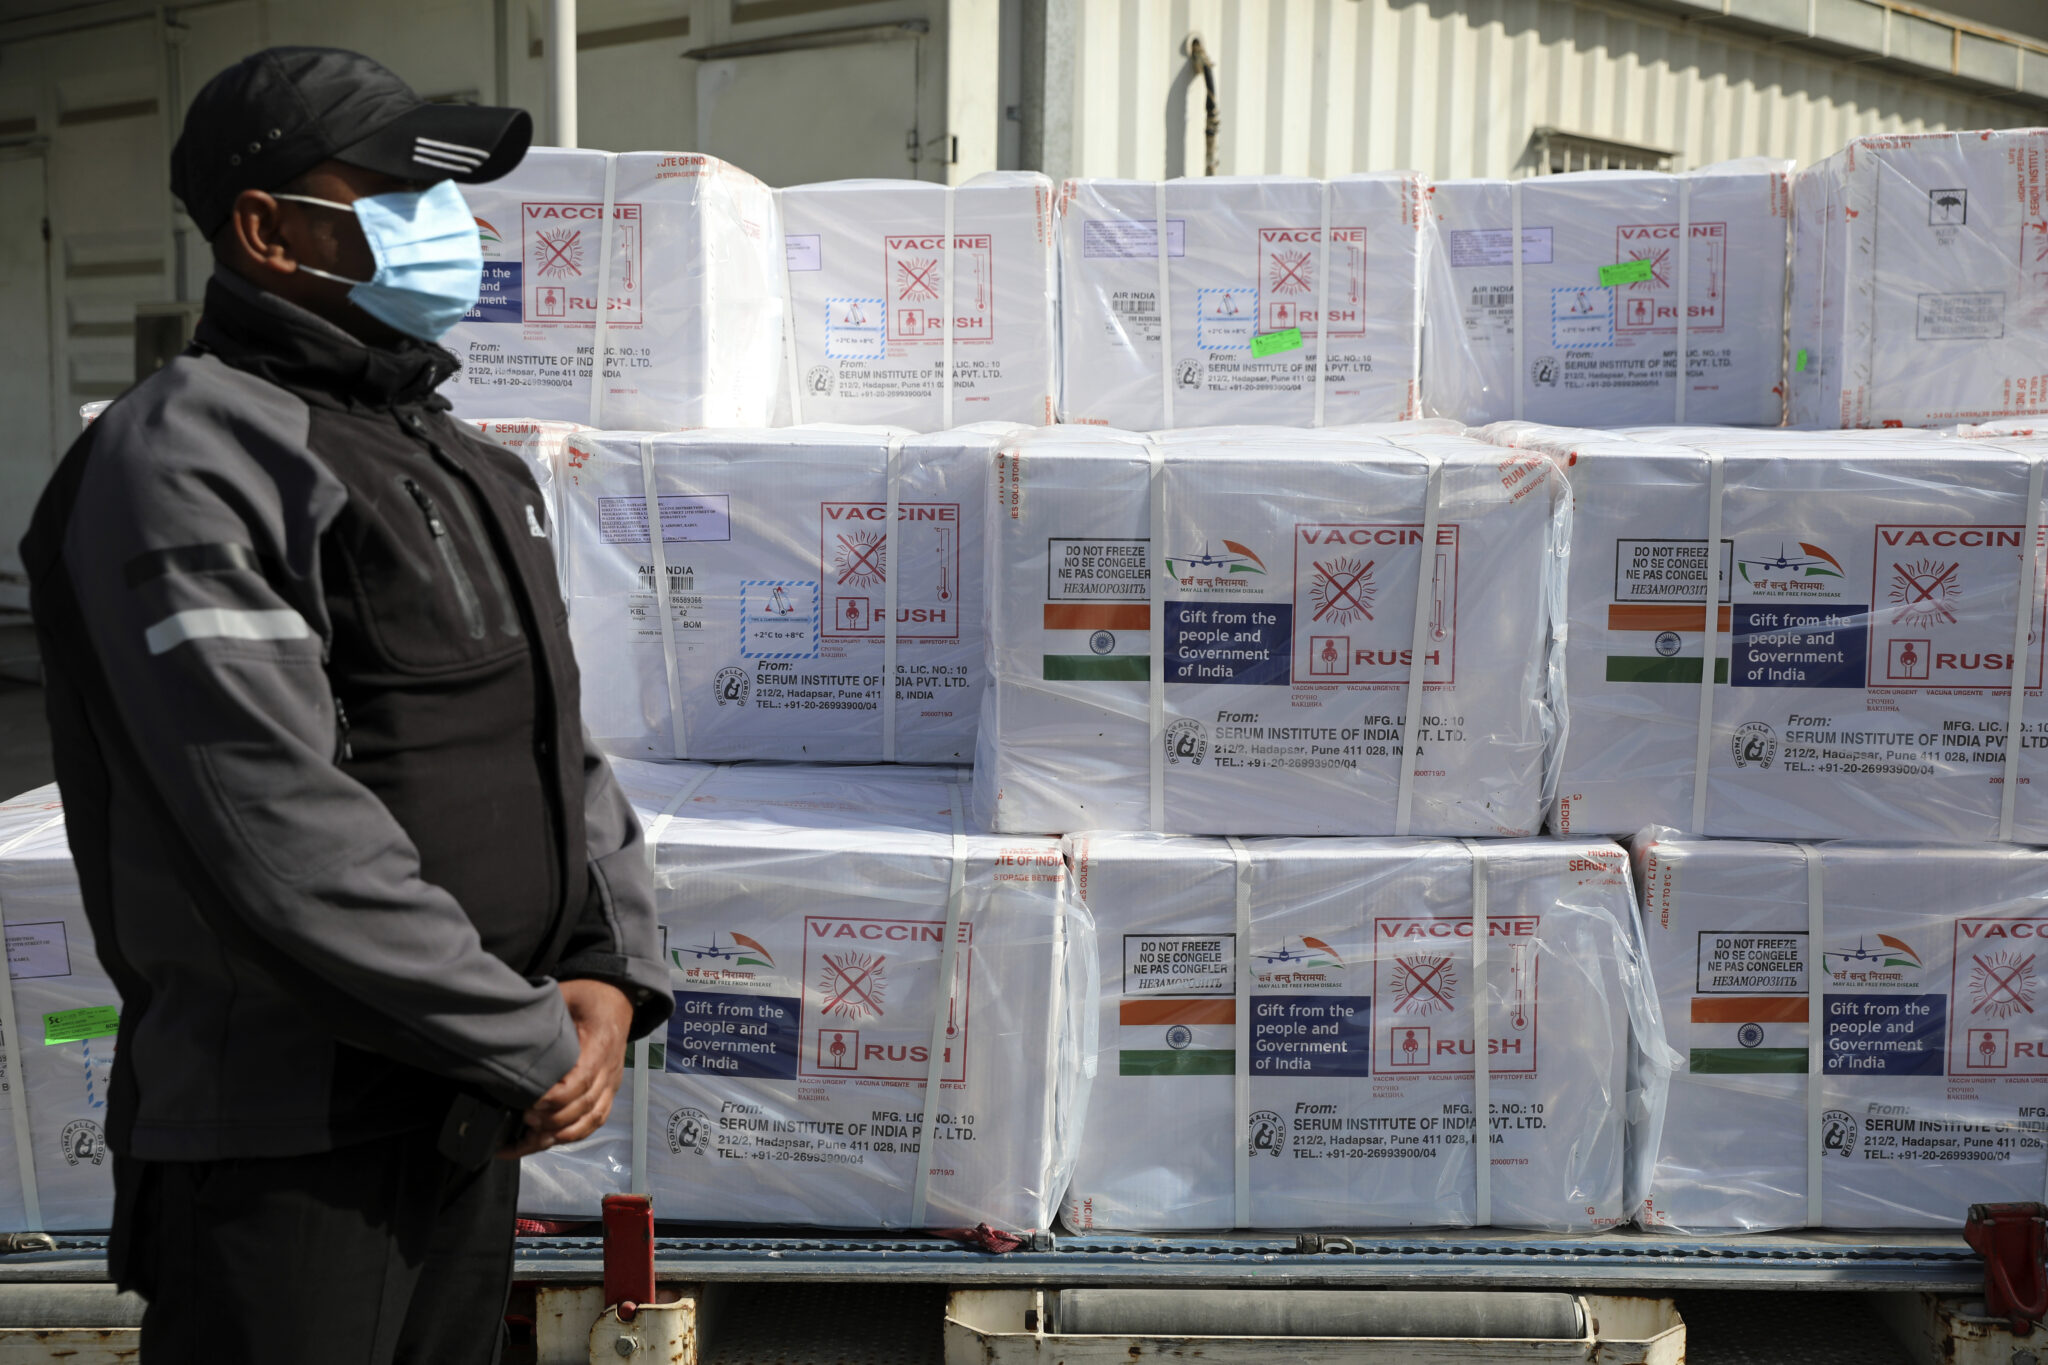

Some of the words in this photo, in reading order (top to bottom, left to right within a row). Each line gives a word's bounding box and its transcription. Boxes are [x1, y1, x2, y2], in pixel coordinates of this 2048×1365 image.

[1263, 231, 1364, 243] VACCNE
[493, 268, 510, 278] the
[470, 341, 500, 352] From:
[469, 354, 504, 364] SERUM
[507, 355, 557, 365] INSTITUTE
[560, 357, 573, 365] OF
[1209, 352, 1237, 362] From:
[840, 360, 867, 369] From:
[1208, 364, 1240, 372] SERUM
[1243, 364, 1288, 372] INSTITUTE
[1290, 364, 1302, 372] OF
[1565, 360, 1597, 370] SERUM
[1599, 360, 1645, 369] INSTITUTE
[1648, 360, 1661, 368] OF
[839, 371, 870, 379] SERUM
[873, 371, 918, 379] INSTITUTE
[921, 371, 932, 379] OF
[496, 424, 528, 434] SERUM
[1301, 530, 1454, 545] VACCINE
[1066, 546, 1080, 556] DO
[1083, 546, 1104, 556] NOT
[1106, 546, 1145, 556] FREEZE
[1635, 547, 1649, 557] DO
[1652, 547, 1673, 557] NOT
[1065, 558, 1079, 567] NO
[1082, 558, 1095, 567] SE
[1097, 558, 1146, 567] CONGELE
[1058, 568, 1072, 578] NE
[1075, 569, 1094, 578] PAS
[1180, 610, 1207, 623] Gift
[1212, 612, 1246, 624] from
[1252, 612, 1276, 624] the
[1750, 614, 1778, 626] Gift
[1784, 615, 1820, 627] from
[1179, 630, 1228, 644] people
[1234, 630, 1261, 642] and
[1749, 634, 1800, 648] people
[1807, 633, 1834, 645] and
[1179, 647, 1269, 660] Government
[1749, 651, 1844, 664] Government
[758, 661, 793, 671] From:
[910, 666, 929, 674] LIC.
[932, 666, 954, 674] NO.:
[956, 666, 967, 674] 10
[1178, 664, 1194, 677] of
[1198, 665, 1233, 677] India
[1748, 668, 1764, 680] of
[1769, 668, 1805, 681] India
[756, 675, 797, 686] SERUM
[801, 676, 859, 686] INSTITUTE
[916, 677, 941, 687] PVT.
[945, 678, 969, 688] LTD.
[838, 690, 862, 698] Pune
[865, 691, 881, 699] 411
[907, 691, 933, 700] INDIA
[756, 700, 781, 709] TEL.:
[1217, 711, 1259, 723] From:
[1788, 715, 1832, 727] From:
[1943, 721, 1975, 732] MFG.
[1215, 728, 1264, 740] SERUM
[1268, 728, 1337, 741] INSTITUTE
[1364, 729, 1399, 741] INDIA
[1841, 732, 1914, 746] INSTITUTE
[1942, 734, 1980, 747] INDIA
[1312, 745, 1340, 755] Pune
[1785, 761, 1815, 773] TEL.:
[1381, 921, 1534, 937] VACCNE
[1141, 942, 1156, 951] DO
[1158, 942, 1179, 951] NOT
[1181, 941, 1221, 952] FREEZE
[1716, 939, 1731, 949] DO
[1734, 939, 1754, 949] NOT
[1173, 953, 1221, 963] CONGELE
[1714, 951, 1729, 960] NO
[1732, 951, 1745, 960] SE
[1748, 951, 1797, 960] CONGELE
[1150, 964, 1169, 974] PAS
[684, 1001, 713, 1015] Gift
[718, 1002, 754, 1017] from
[758, 1004, 784, 1018] the
[1257, 1004, 1285, 1017] Gift
[1289, 1005, 1325, 1017] from
[1330, 1005, 1355, 1017] the
[1831, 1002, 1859, 1015] Gift
[1864, 1004, 1899, 1015] from
[1905, 1003, 1930, 1015] the
[684, 1020, 735, 1037] people
[740, 1022, 768, 1036] and
[1257, 1023, 1307, 1036] people
[1312, 1022, 1339, 1035] and
[1830, 1021, 1881, 1035] people
[1886, 1021, 1914, 1033] and
[683, 1037, 776, 1055] Government
[1256, 1040, 1347, 1052] Government
[1829, 1038, 1923, 1051] Government
[682, 1055, 698, 1069] of
[702, 1057, 739, 1071] India
[1255, 1057, 1271, 1069] of
[1276, 1057, 1311, 1070] India
[1829, 1055, 1844, 1068] of
[1849, 1056, 1886, 1069] India
[1295, 1103, 1337, 1115] From:
[719, 1117, 766, 1131] SERUM
[773, 1119, 844, 1135] INSTITUTE
[871, 1125, 908, 1139] INDIA
[947, 1128, 976, 1141] LTD.
[1293, 1118, 1341, 1131] SERUM
[1346, 1118, 1416, 1131] INSTITUTE
[1865, 1119, 1915, 1132] SERUM
[850, 1140, 870, 1151] 411
[1391, 1135, 1419, 1145] Pune
[1423, 1135, 1443, 1145] 411
[1964, 1137, 1993, 1147] Pune
[1996, 1138, 2017, 1147] 411
[1326, 1149, 1436, 1159] +91-20-26993900/04
[1898, 1150, 2010, 1161] +91-20-26993900/04
